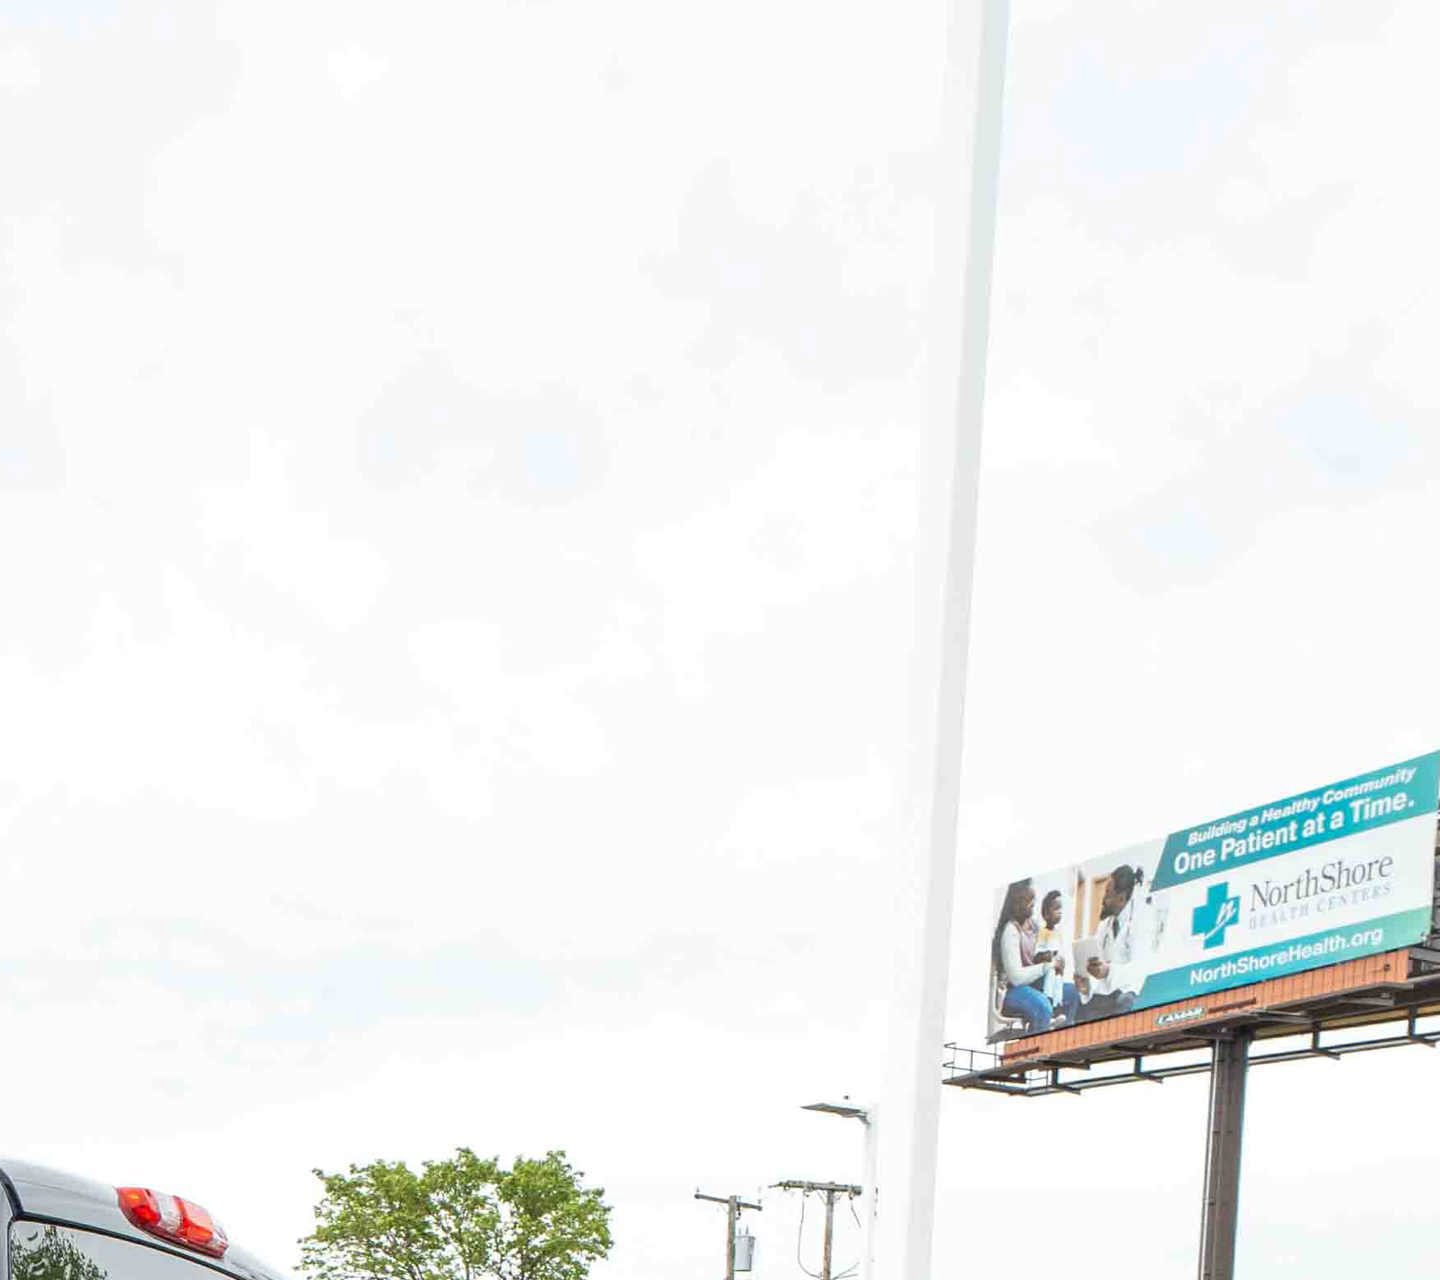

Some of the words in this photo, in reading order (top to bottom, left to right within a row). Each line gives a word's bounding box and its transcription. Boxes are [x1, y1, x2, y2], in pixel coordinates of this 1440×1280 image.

[1174, 849, 1216, 874] One
[1220, 819, 1298, 862] Patient
[1302, 813, 1326, 838] at
[1329, 810, 1344, 831] a
[1348, 791, 1415, 824] Time.
[1187, 817, 1247, 847] Building
[1248, 814, 1260, 826] a
[1260, 795, 1321, 825] Healthy
[1322, 767, 1416, 805] Community
[1249, 855, 1393, 913] NorthShore
[1249, 903, 1310, 931] HEALTH
[1317, 882, 1392, 913] CENTERS
[1189, 927, 1385, 986] NorthShoreHealth.org
